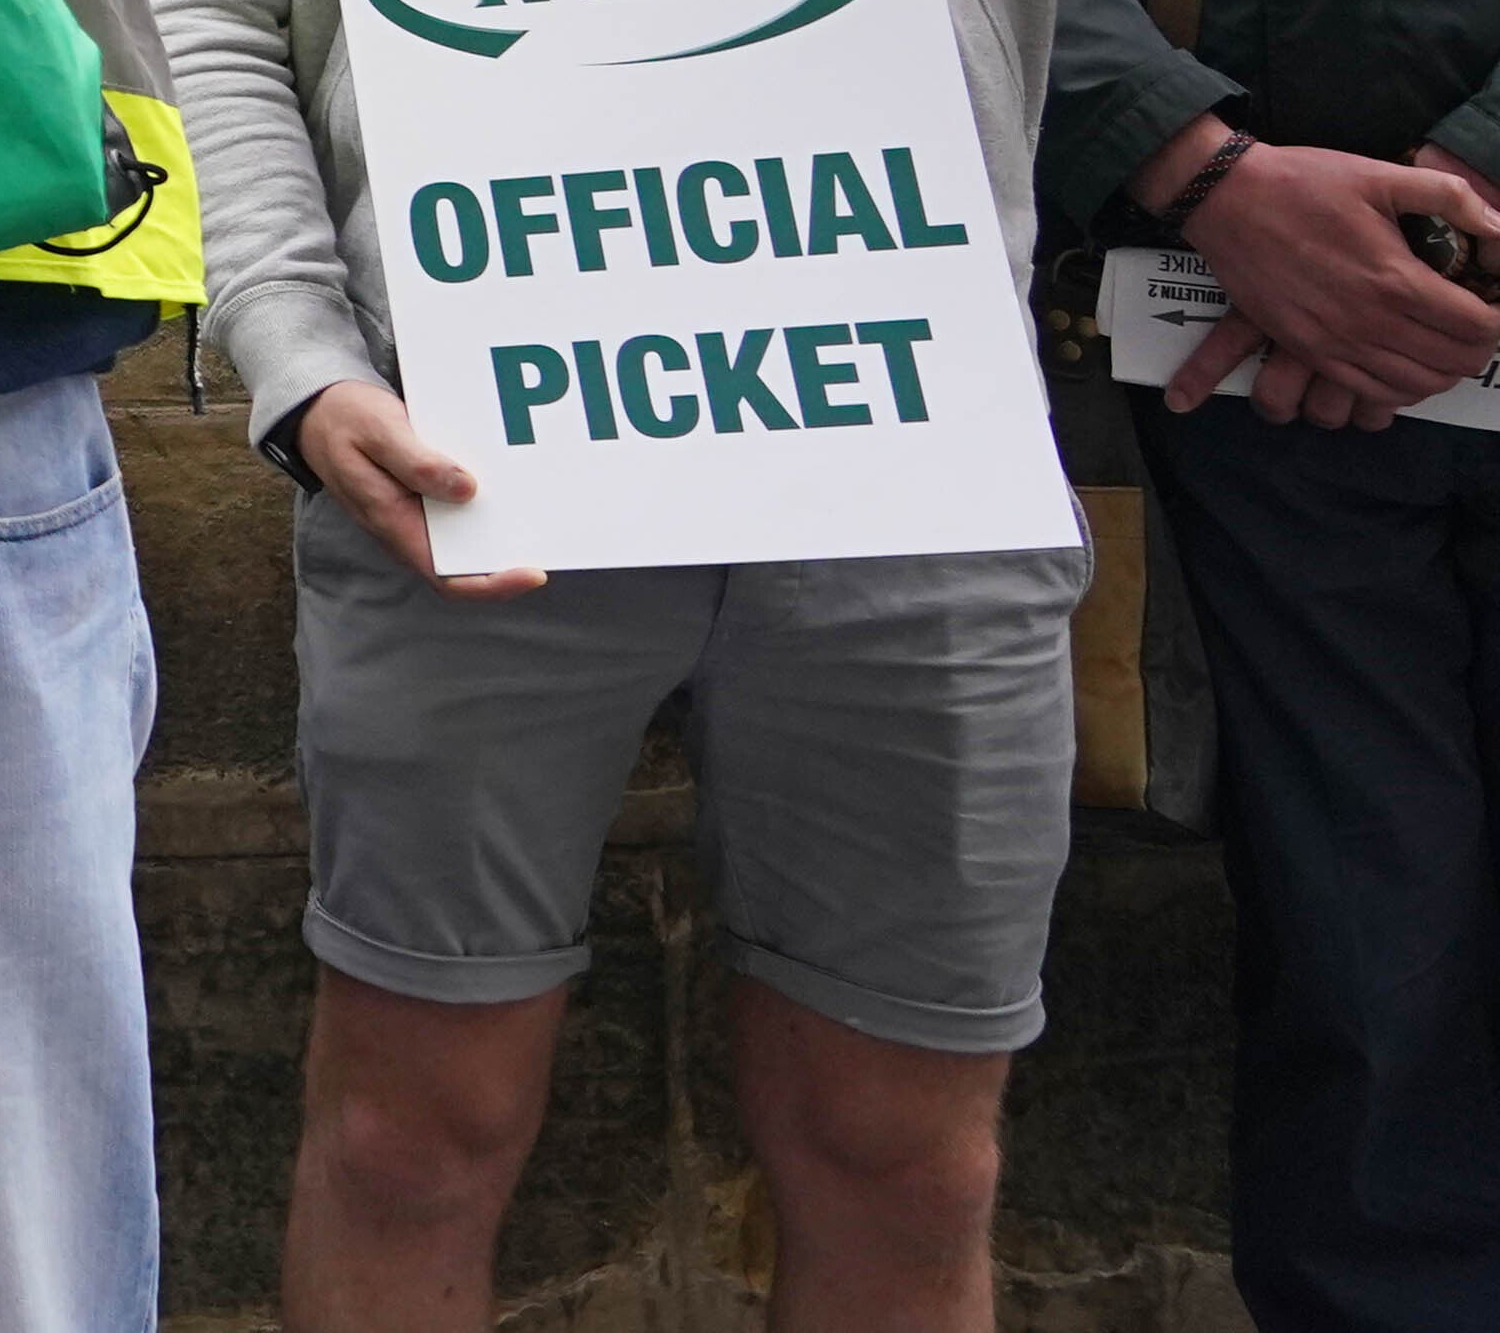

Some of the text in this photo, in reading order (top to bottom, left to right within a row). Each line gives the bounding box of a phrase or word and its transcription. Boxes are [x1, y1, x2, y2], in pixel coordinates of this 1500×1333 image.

[409, 146, 970, 285] OFFICIAL
[1148, 283, 1227, 306] BULLETIN 2
[490, 318, 934, 447] PICKET
